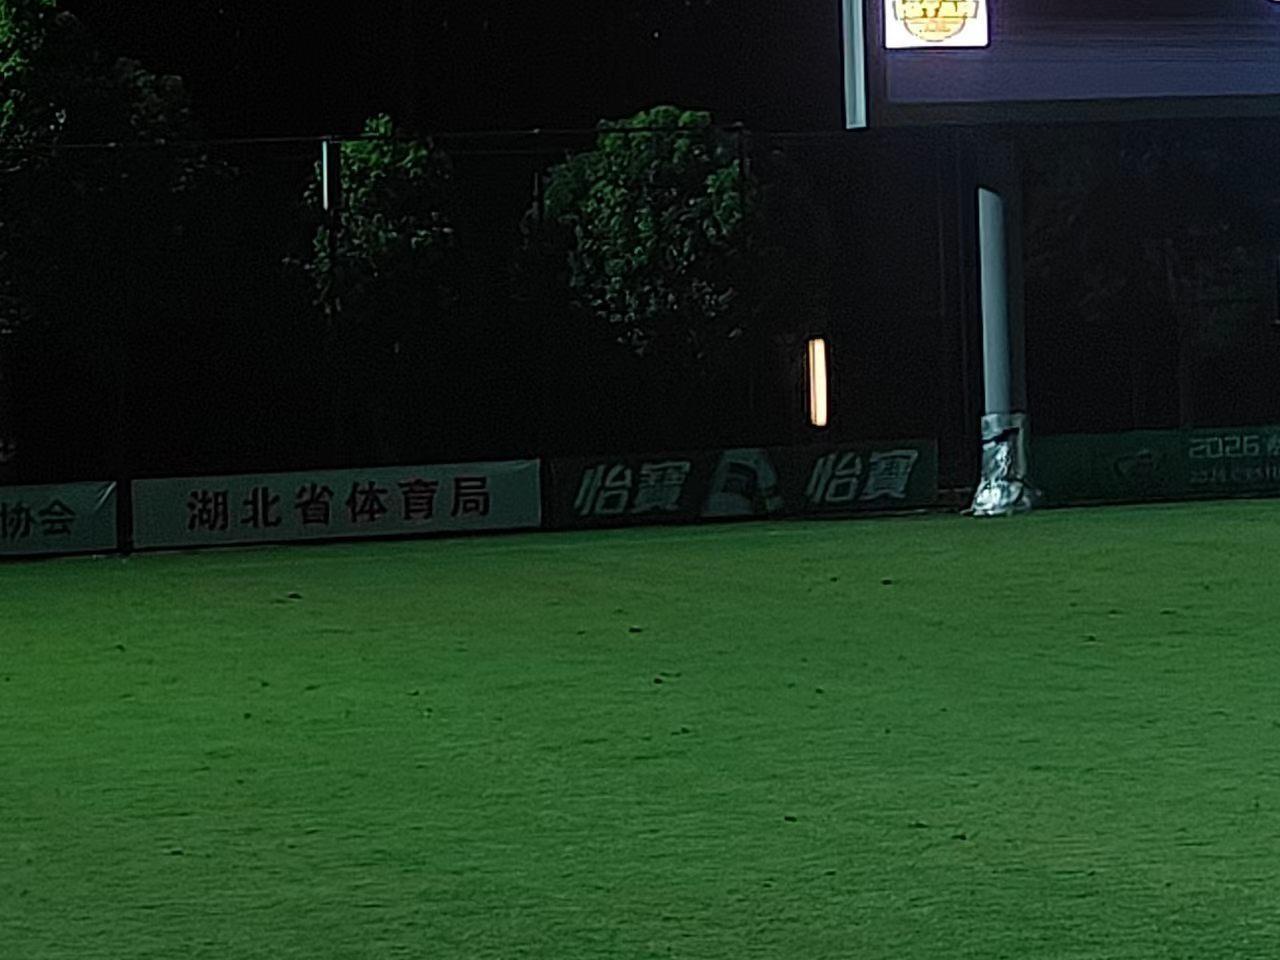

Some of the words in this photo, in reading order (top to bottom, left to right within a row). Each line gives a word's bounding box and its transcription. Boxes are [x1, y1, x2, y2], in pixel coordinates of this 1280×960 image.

[186, 476, 490, 532] 湖北省体育局
